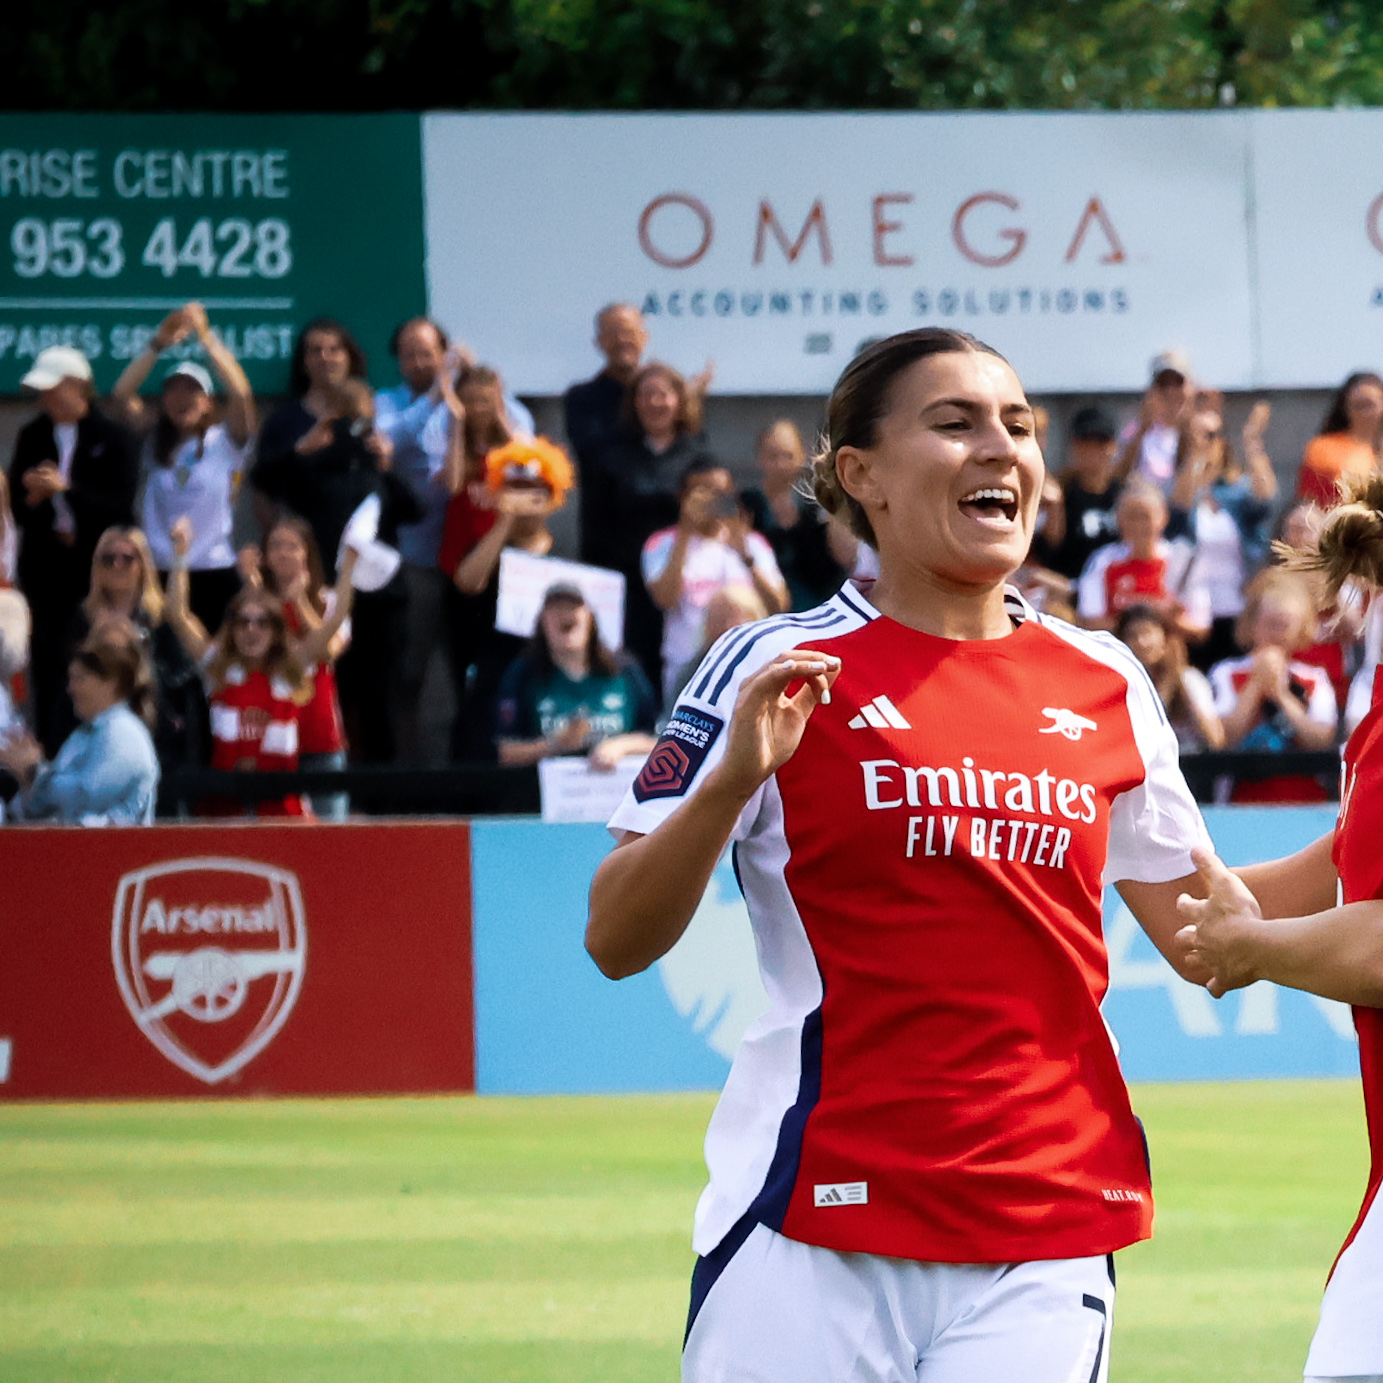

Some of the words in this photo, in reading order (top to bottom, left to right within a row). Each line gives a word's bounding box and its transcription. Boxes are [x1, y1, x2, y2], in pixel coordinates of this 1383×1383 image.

[113, 149, 290, 198] CENTRE
[11, 216, 125, 278] 953
[142, 216, 293, 278] 4428
[638, 192, 1127, 268] OMEGA
[641, 288, 888, 317] ACCOUNTING
[911, 287, 1130, 316] SOLUTIONS
[859, 757, 1097, 824] Emirates
[906, 816, 959, 859] FLY
[970, 817, 1072, 869] BETTER
[141, 899, 275, 934] Arsenal
